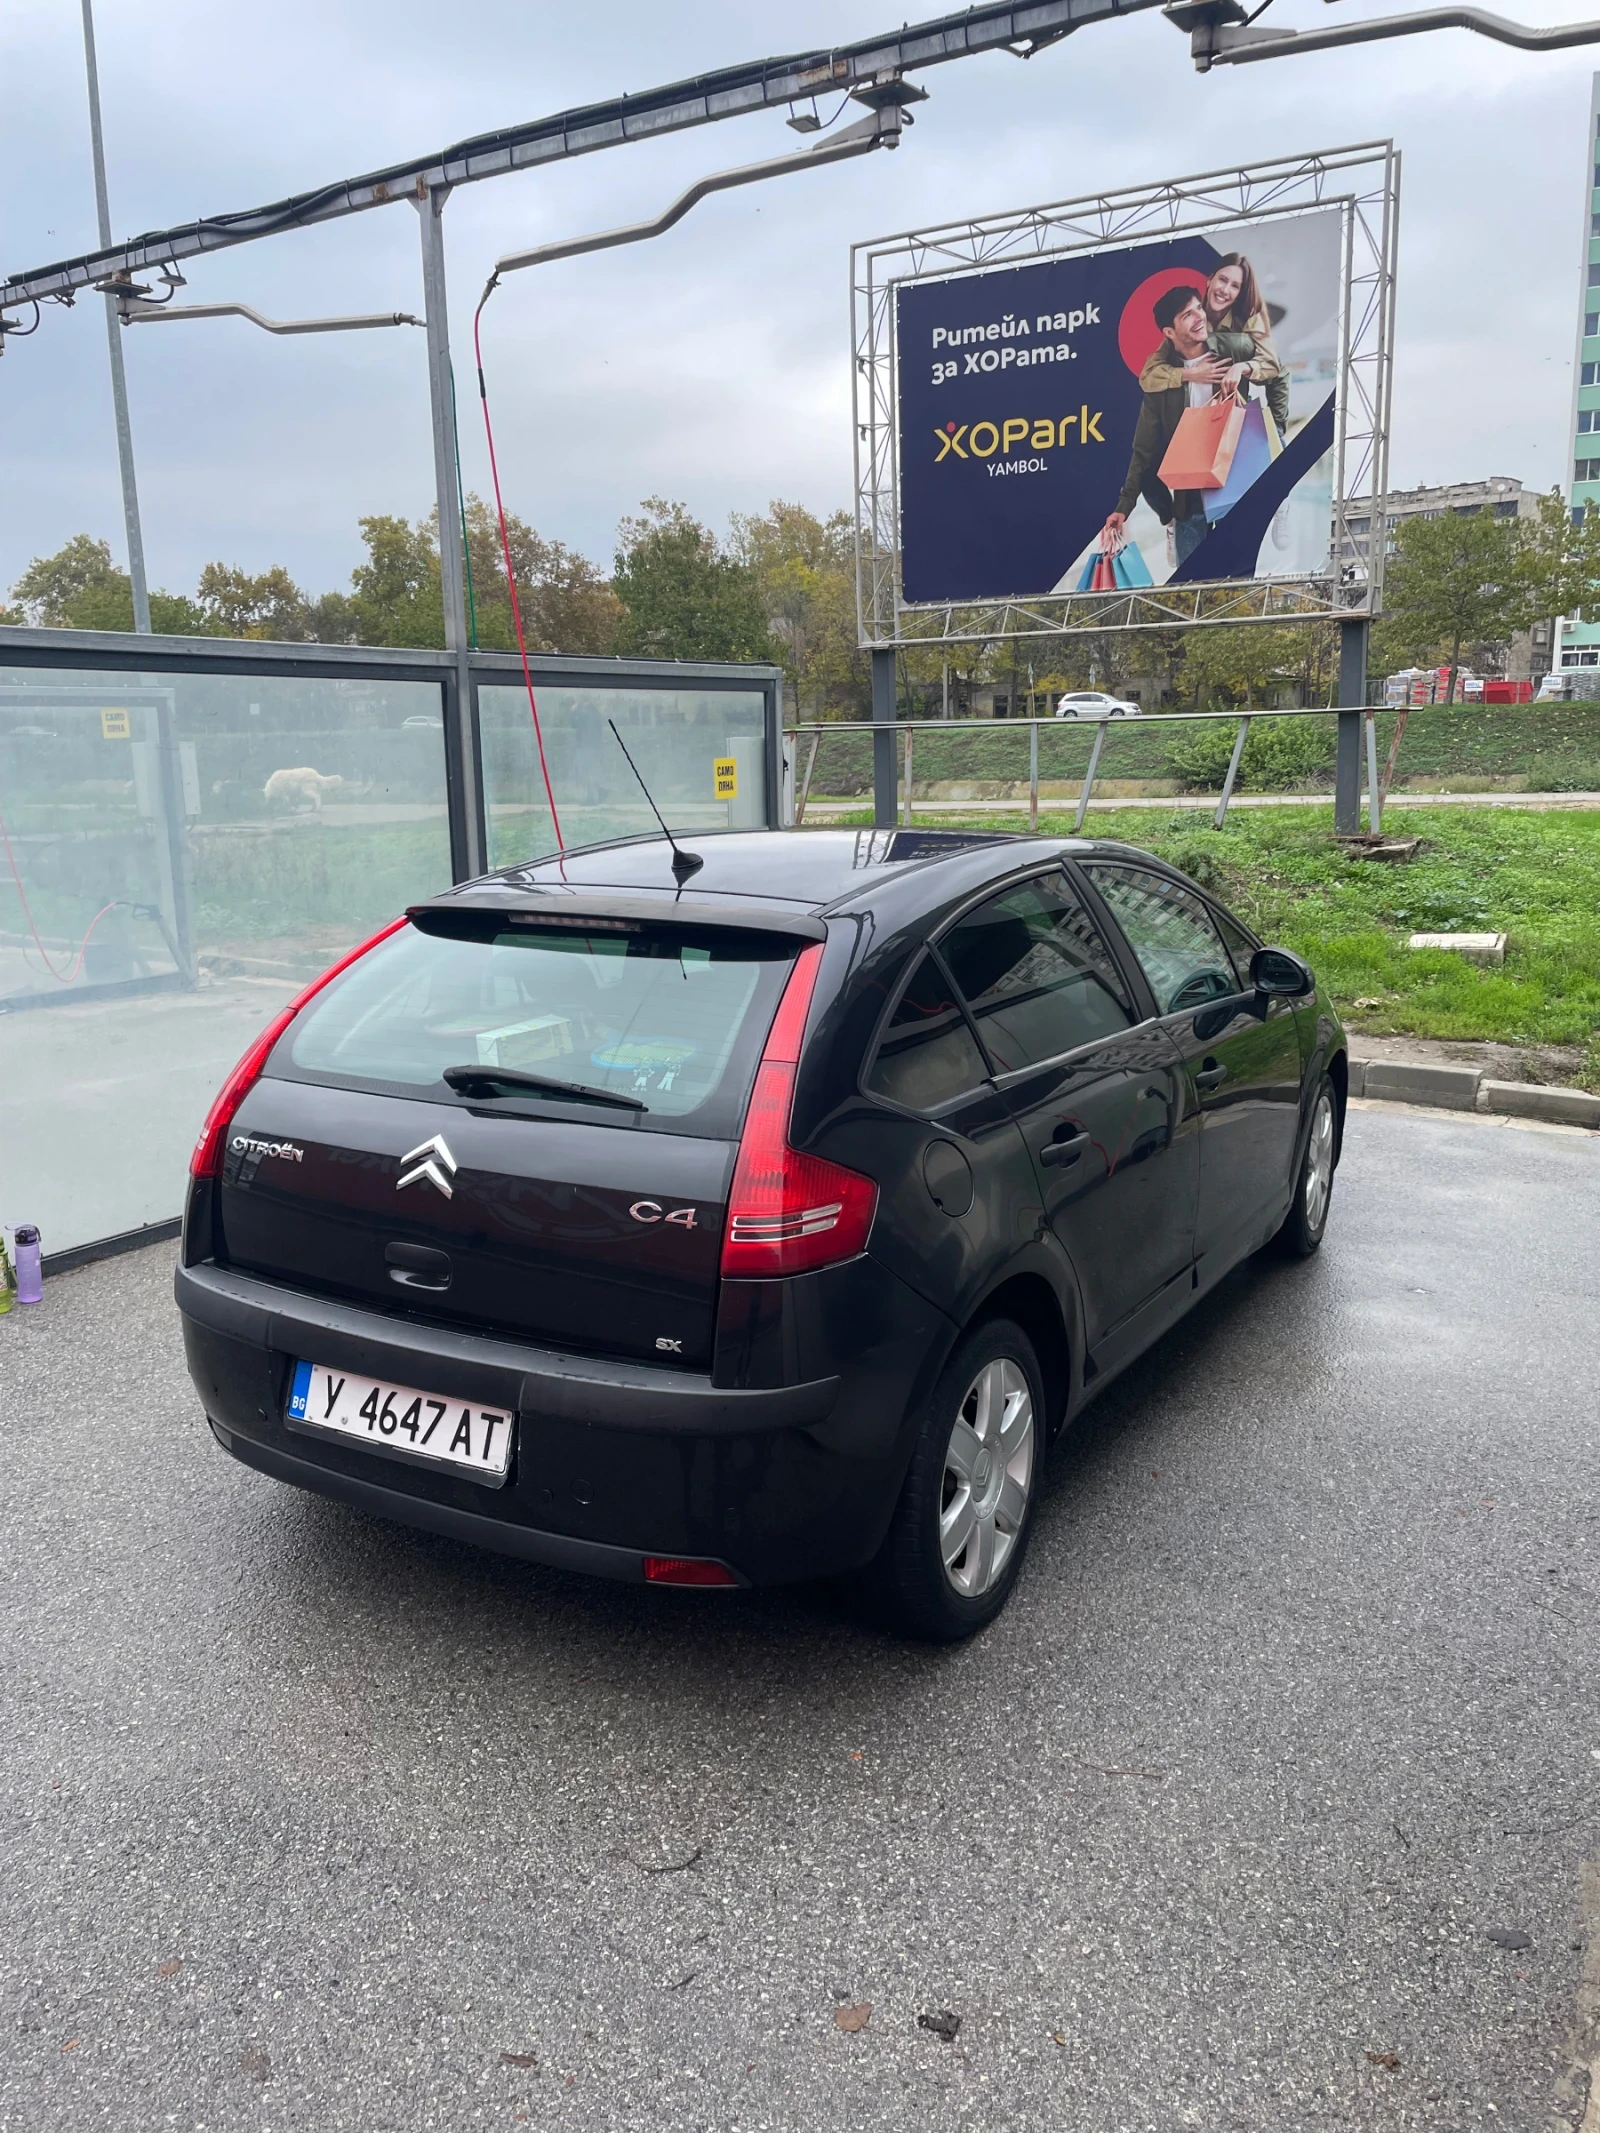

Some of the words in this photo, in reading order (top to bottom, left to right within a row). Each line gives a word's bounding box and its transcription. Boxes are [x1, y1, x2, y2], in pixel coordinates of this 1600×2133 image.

[932, 314, 1030, 349] Ритейл
[1036, 302, 1101, 334] парк
[963, 343, 1078, 375] ХОРата.
[934, 404, 1106, 462] XOPark
[986, 457, 1048, 477] YAMBOL
[716, 765, 734, 777] САМО
[629, 1201, 698, 1230] C4
[655, 1337, 682, 1354] SX
[291, 1395, 305, 1411] BG
[359, 1387, 447, 1445] 4647
[449, 1408, 504, 1460] AT
